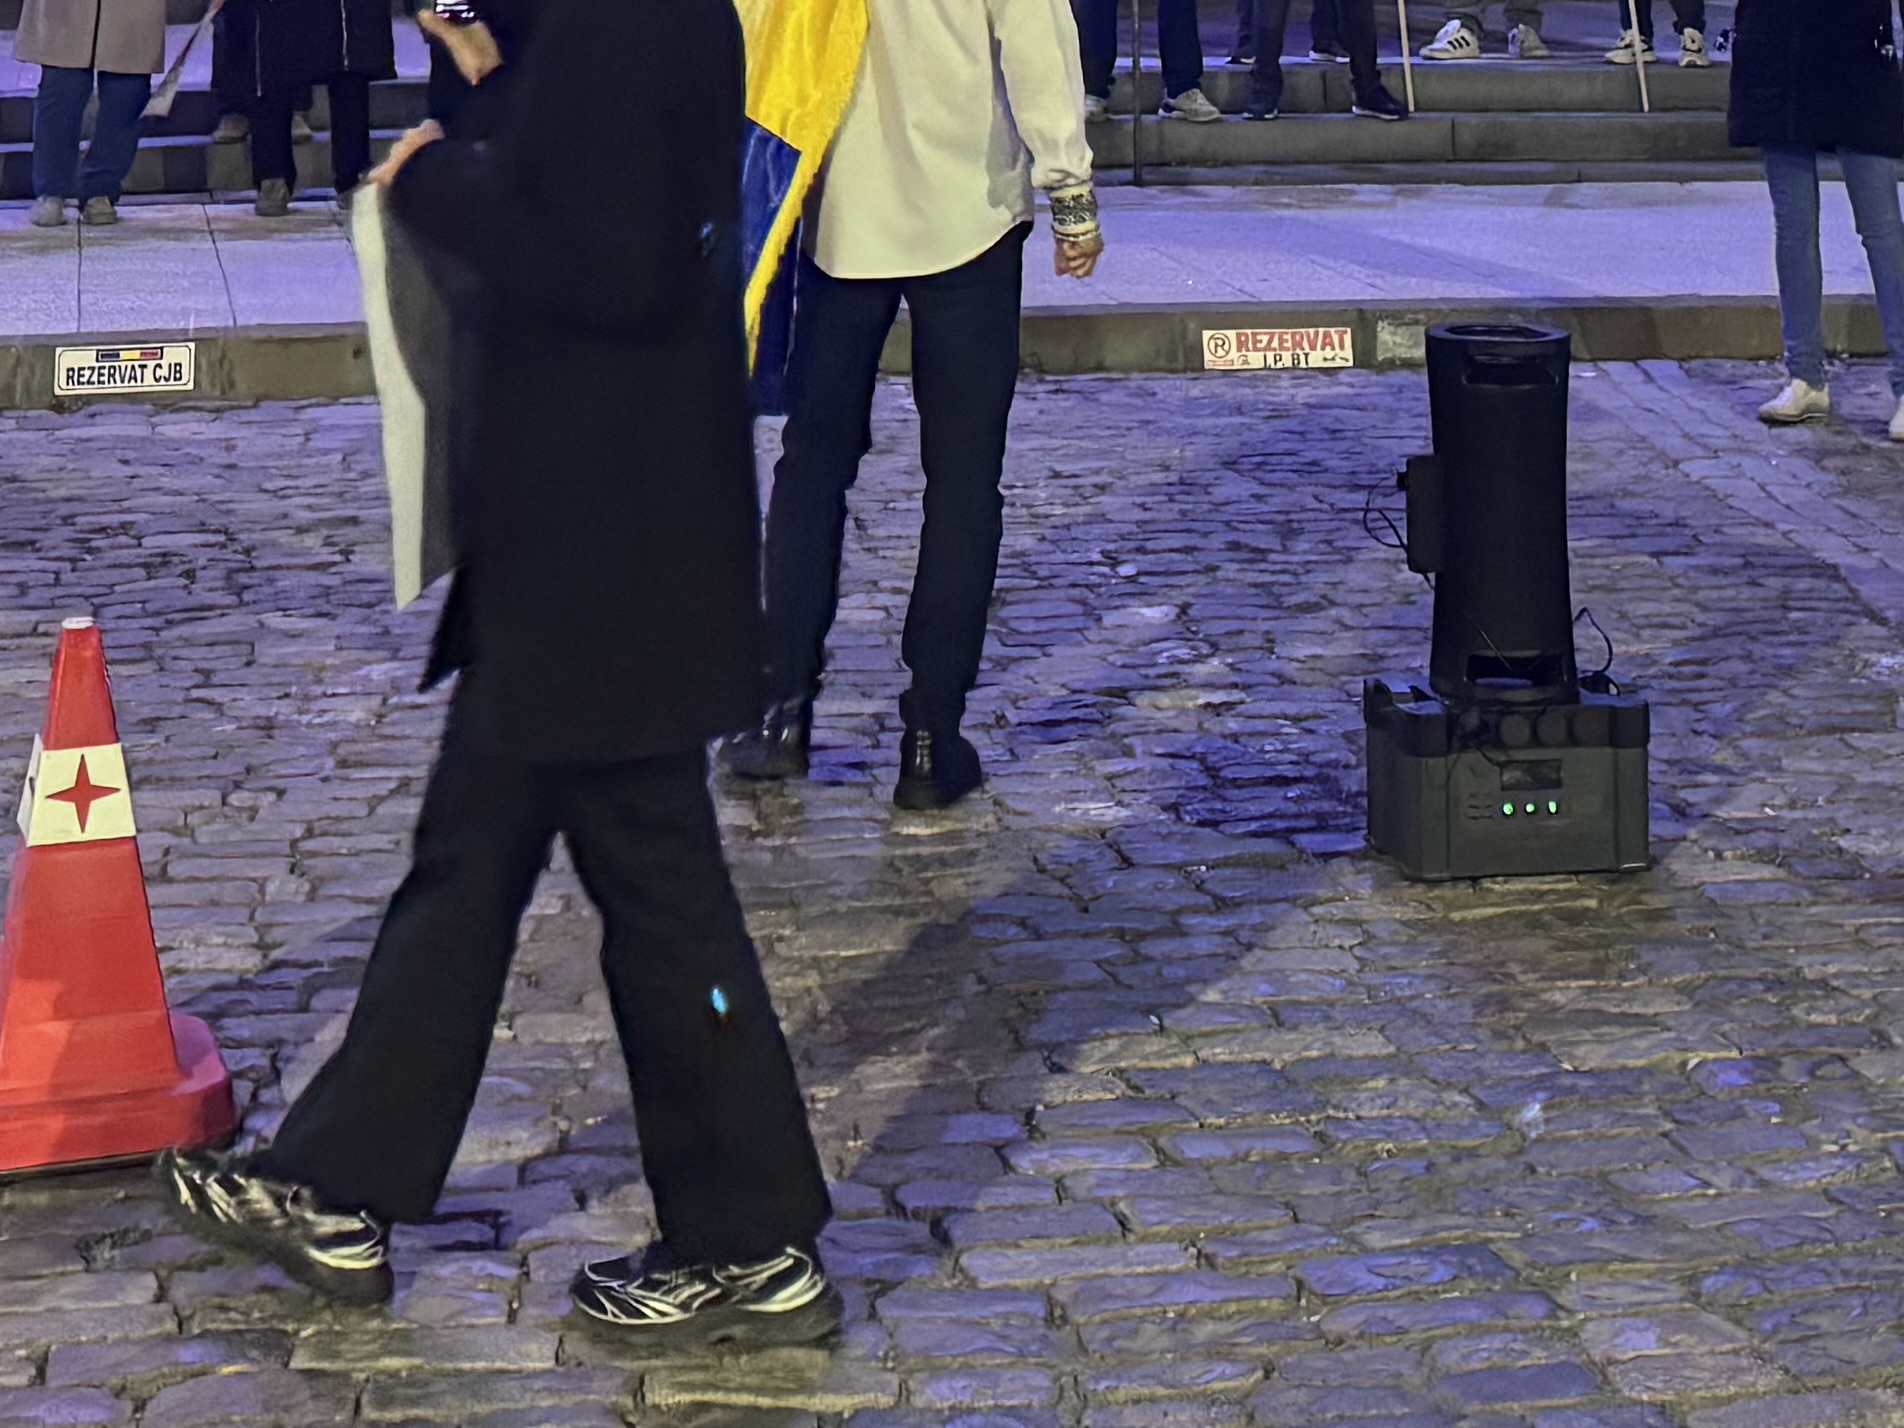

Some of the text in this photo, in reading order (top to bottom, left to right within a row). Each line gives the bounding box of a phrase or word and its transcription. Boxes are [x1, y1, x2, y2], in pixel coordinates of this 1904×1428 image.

[1235, 329, 1348, 353] REZERVAT
[66, 362, 183, 387] REZERVAT CJB
